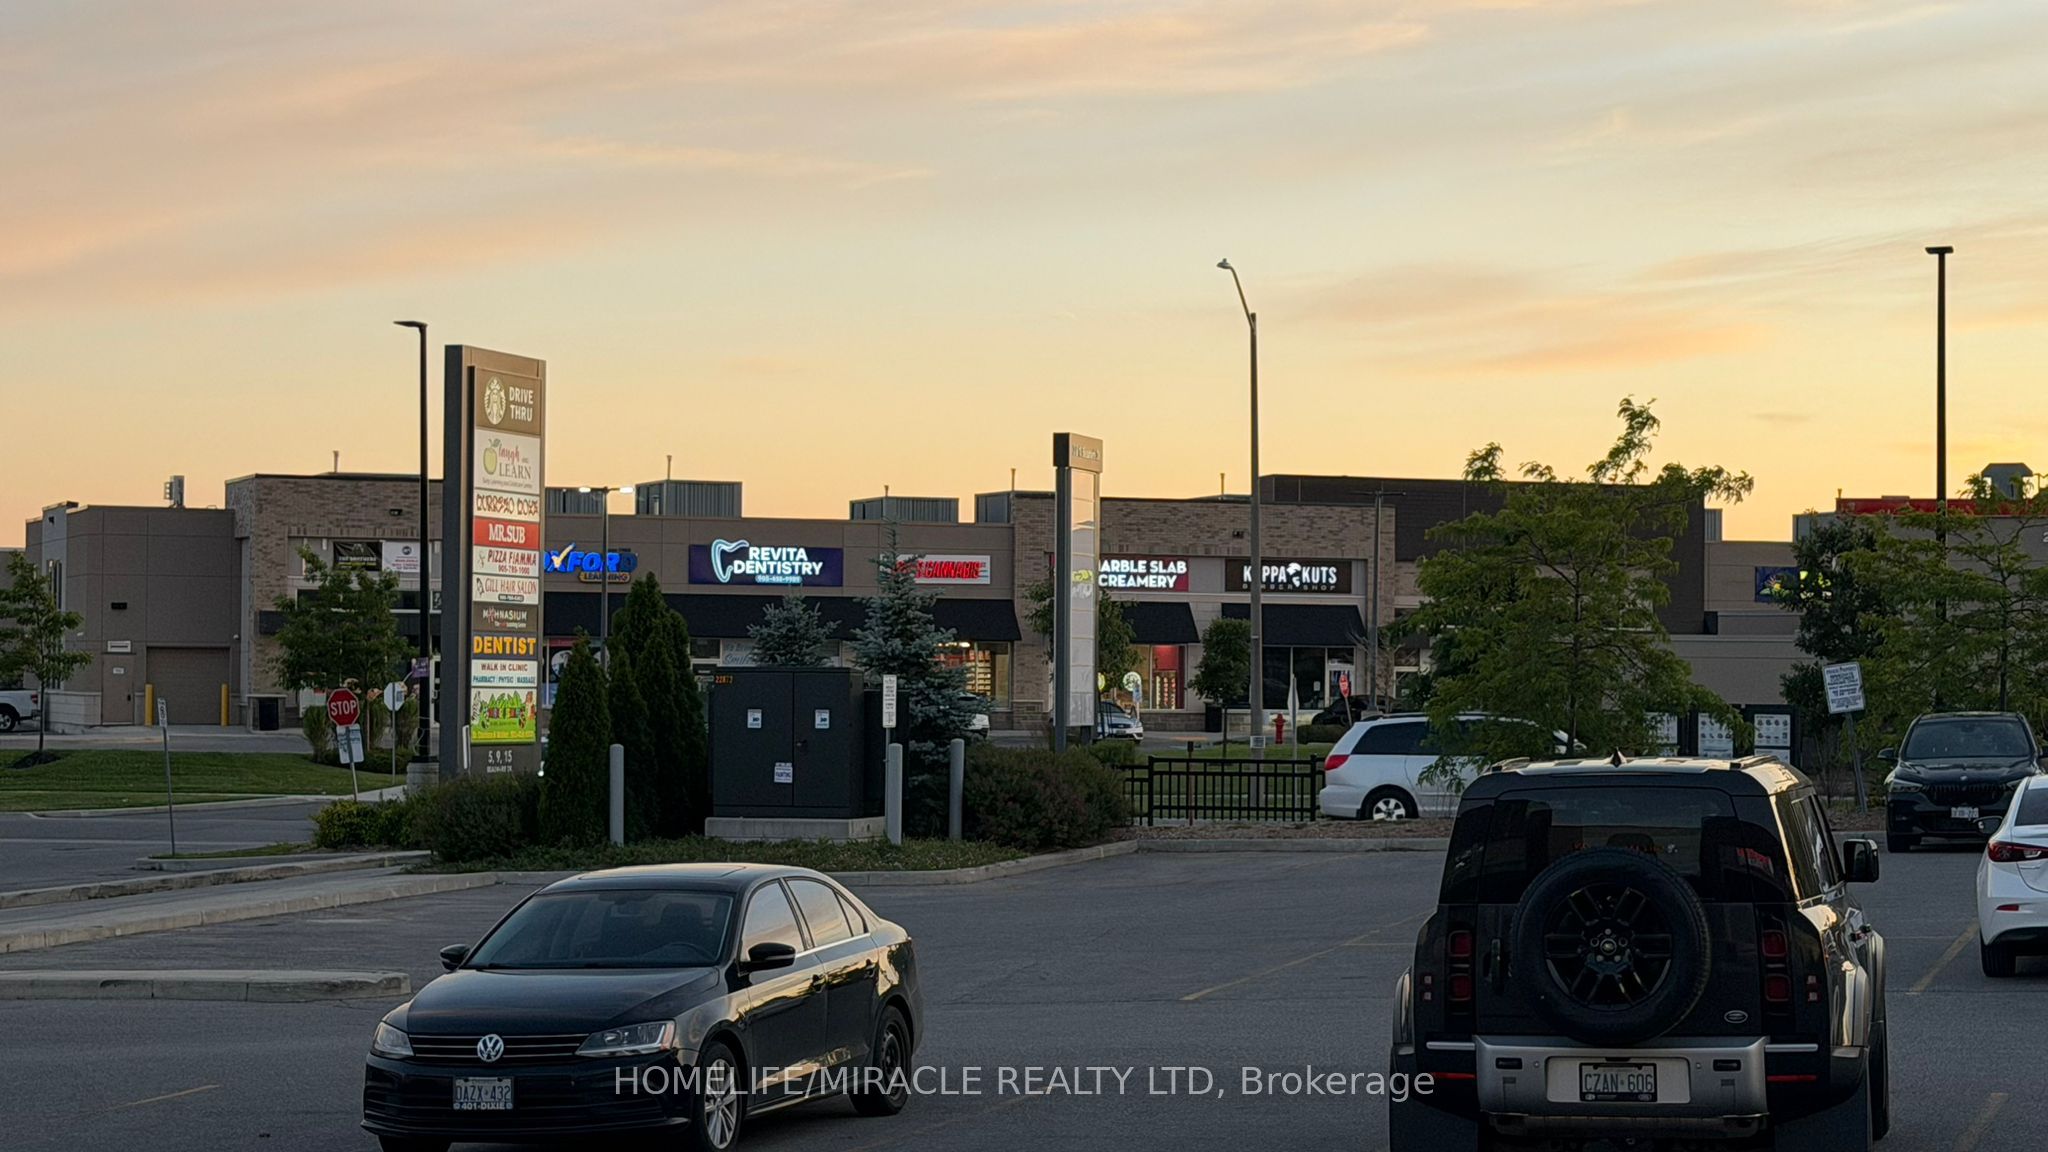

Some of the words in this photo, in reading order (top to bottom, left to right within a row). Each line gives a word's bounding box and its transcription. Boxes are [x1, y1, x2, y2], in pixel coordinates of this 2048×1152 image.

[509, 386, 534, 405] DRIVE
[510, 405, 533, 422] THRU
[499, 462, 532, 480] LEARN
[487, 549, 507, 563] PIZZA
[748, 546, 808, 561] REVITA
[733, 560, 823, 576] DENTISTRY
[925, 561, 981, 579] CANNABIS
[1098, 559, 1148, 573] ARBLE
[1149, 560, 1188, 574] SLAB
[1243, 565, 1287, 583] KPPA
[1301, 566, 1338, 584] KUTS
[500, 578, 516, 594] HAIR
[517, 580, 537, 595] SALON
[1098, 574, 1177, 588] CREAMERY
[473, 635, 537, 656] DENTIST
[481, 663, 498, 671] WALK
[508, 664, 528, 672] CLINIC
[330, 700, 357, 716] STOP
[504, 749, 513, 764] 15
[1584, 1074, 1619, 1092] CZAN
[1627, 1074, 1653, 1092] 606
